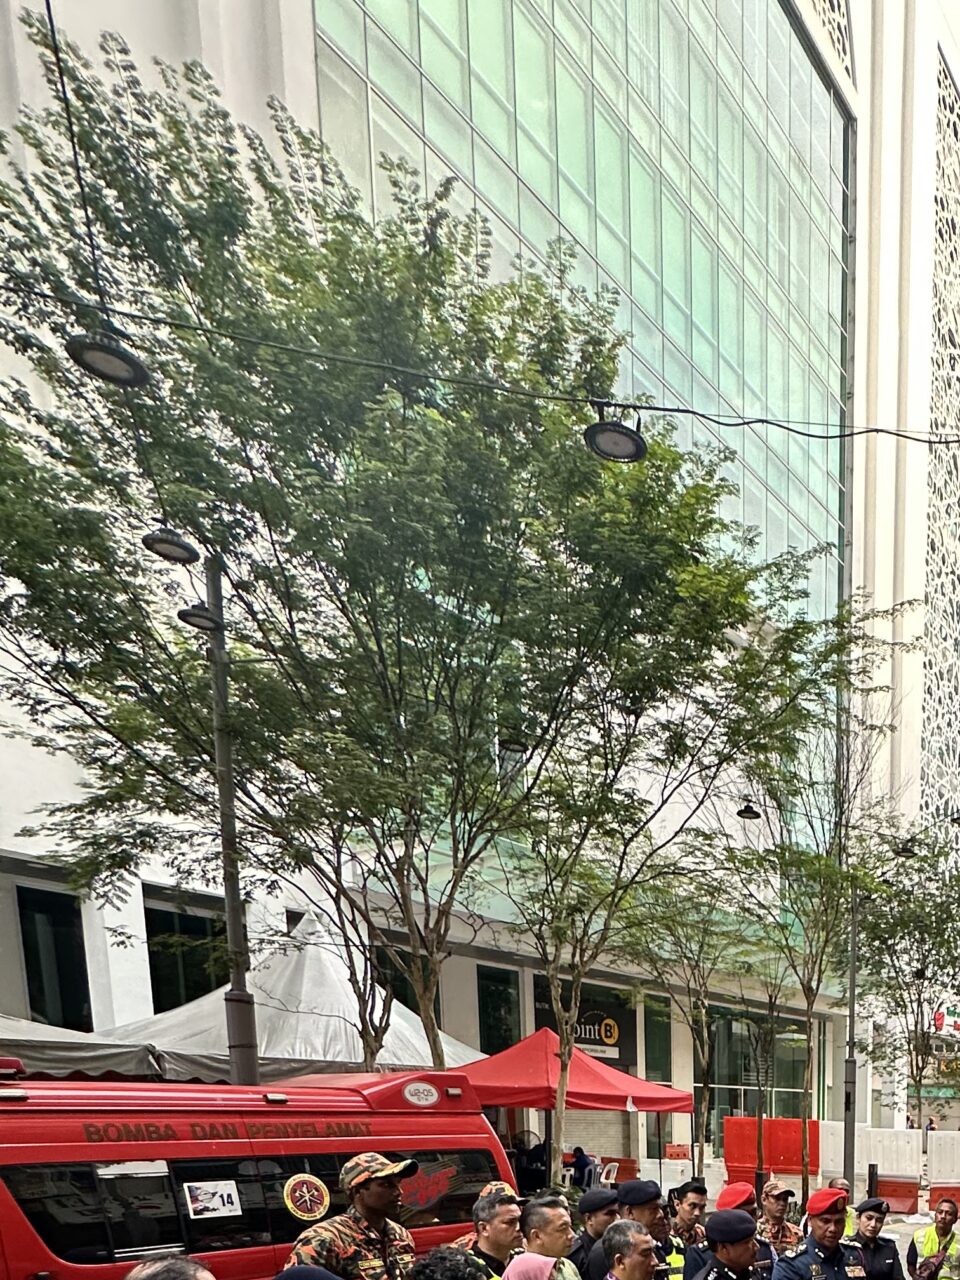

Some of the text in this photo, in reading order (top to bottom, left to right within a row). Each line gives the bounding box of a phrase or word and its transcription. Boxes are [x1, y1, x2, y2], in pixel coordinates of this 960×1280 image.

[83, 1120, 373, 1142] BOMBA DAN PENYELAMAT
[219, 1192, 235, 1208] 14
